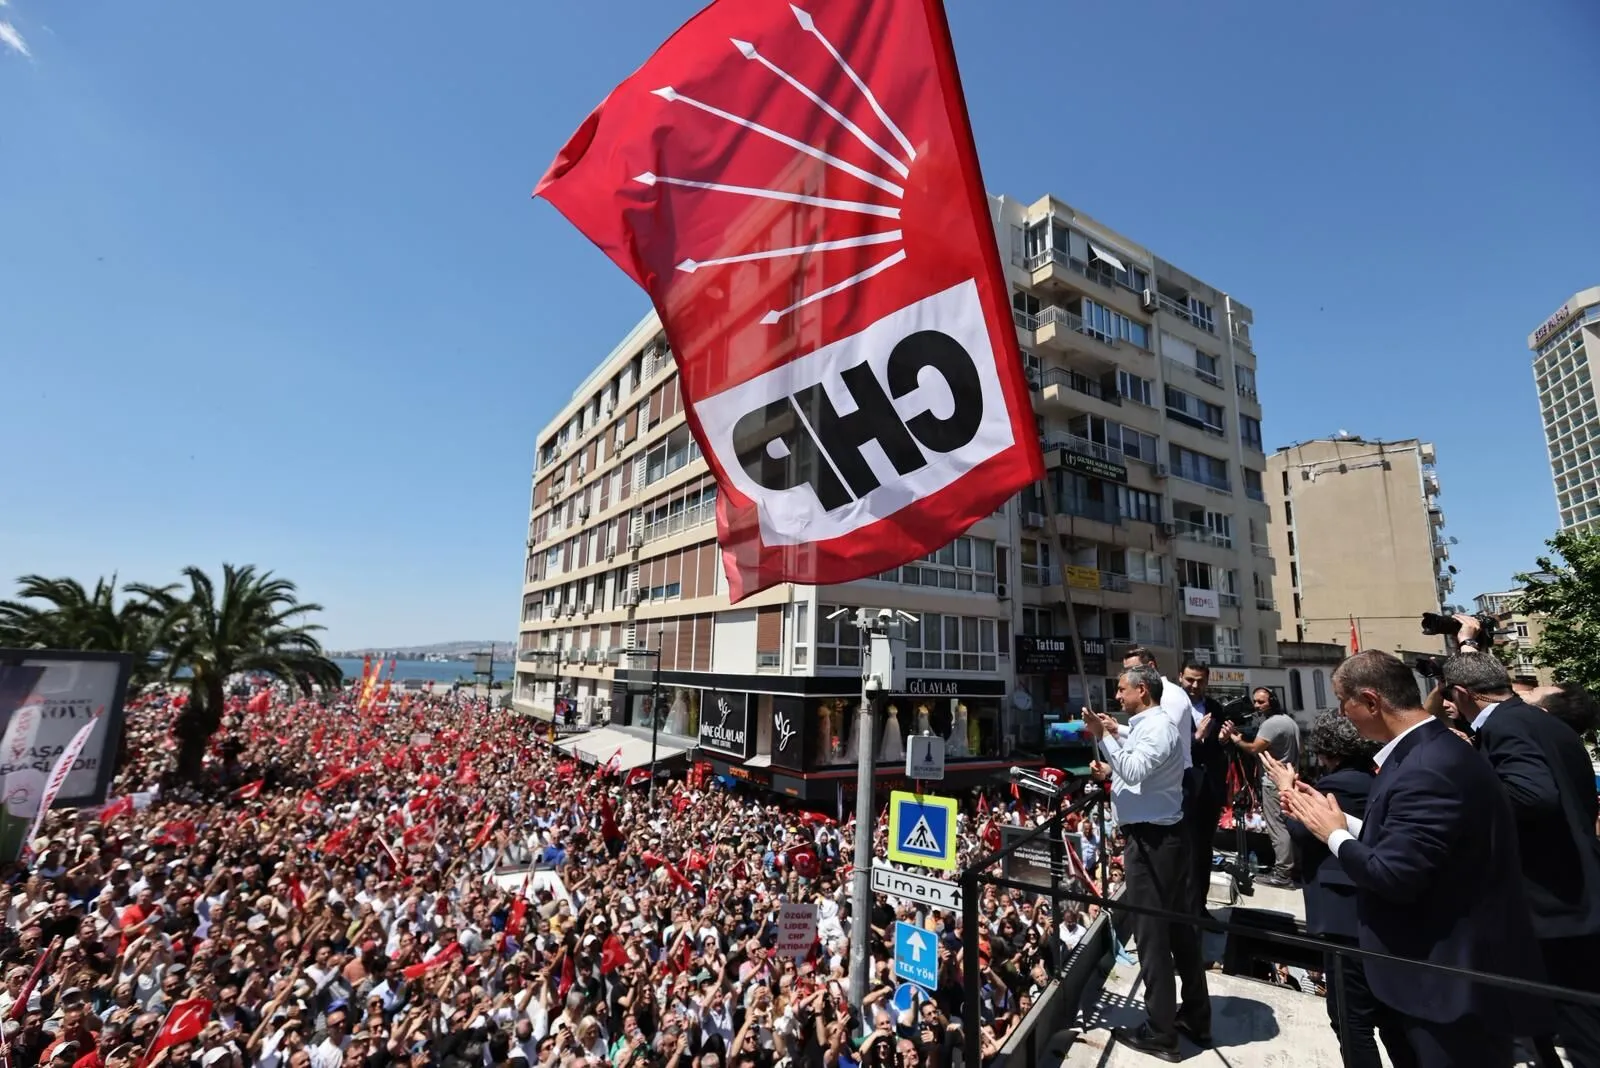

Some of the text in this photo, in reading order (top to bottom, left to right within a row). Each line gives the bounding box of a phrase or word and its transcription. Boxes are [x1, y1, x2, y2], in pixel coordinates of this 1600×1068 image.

[1036, 639, 1065, 651] Tattoo
[1083, 640, 1104, 654] Tattoo
[910, 679, 958, 694] GÜLAYLAR
[875, 871, 942, 900] Liman
[899, 961, 934, 981] TEK YÖN
